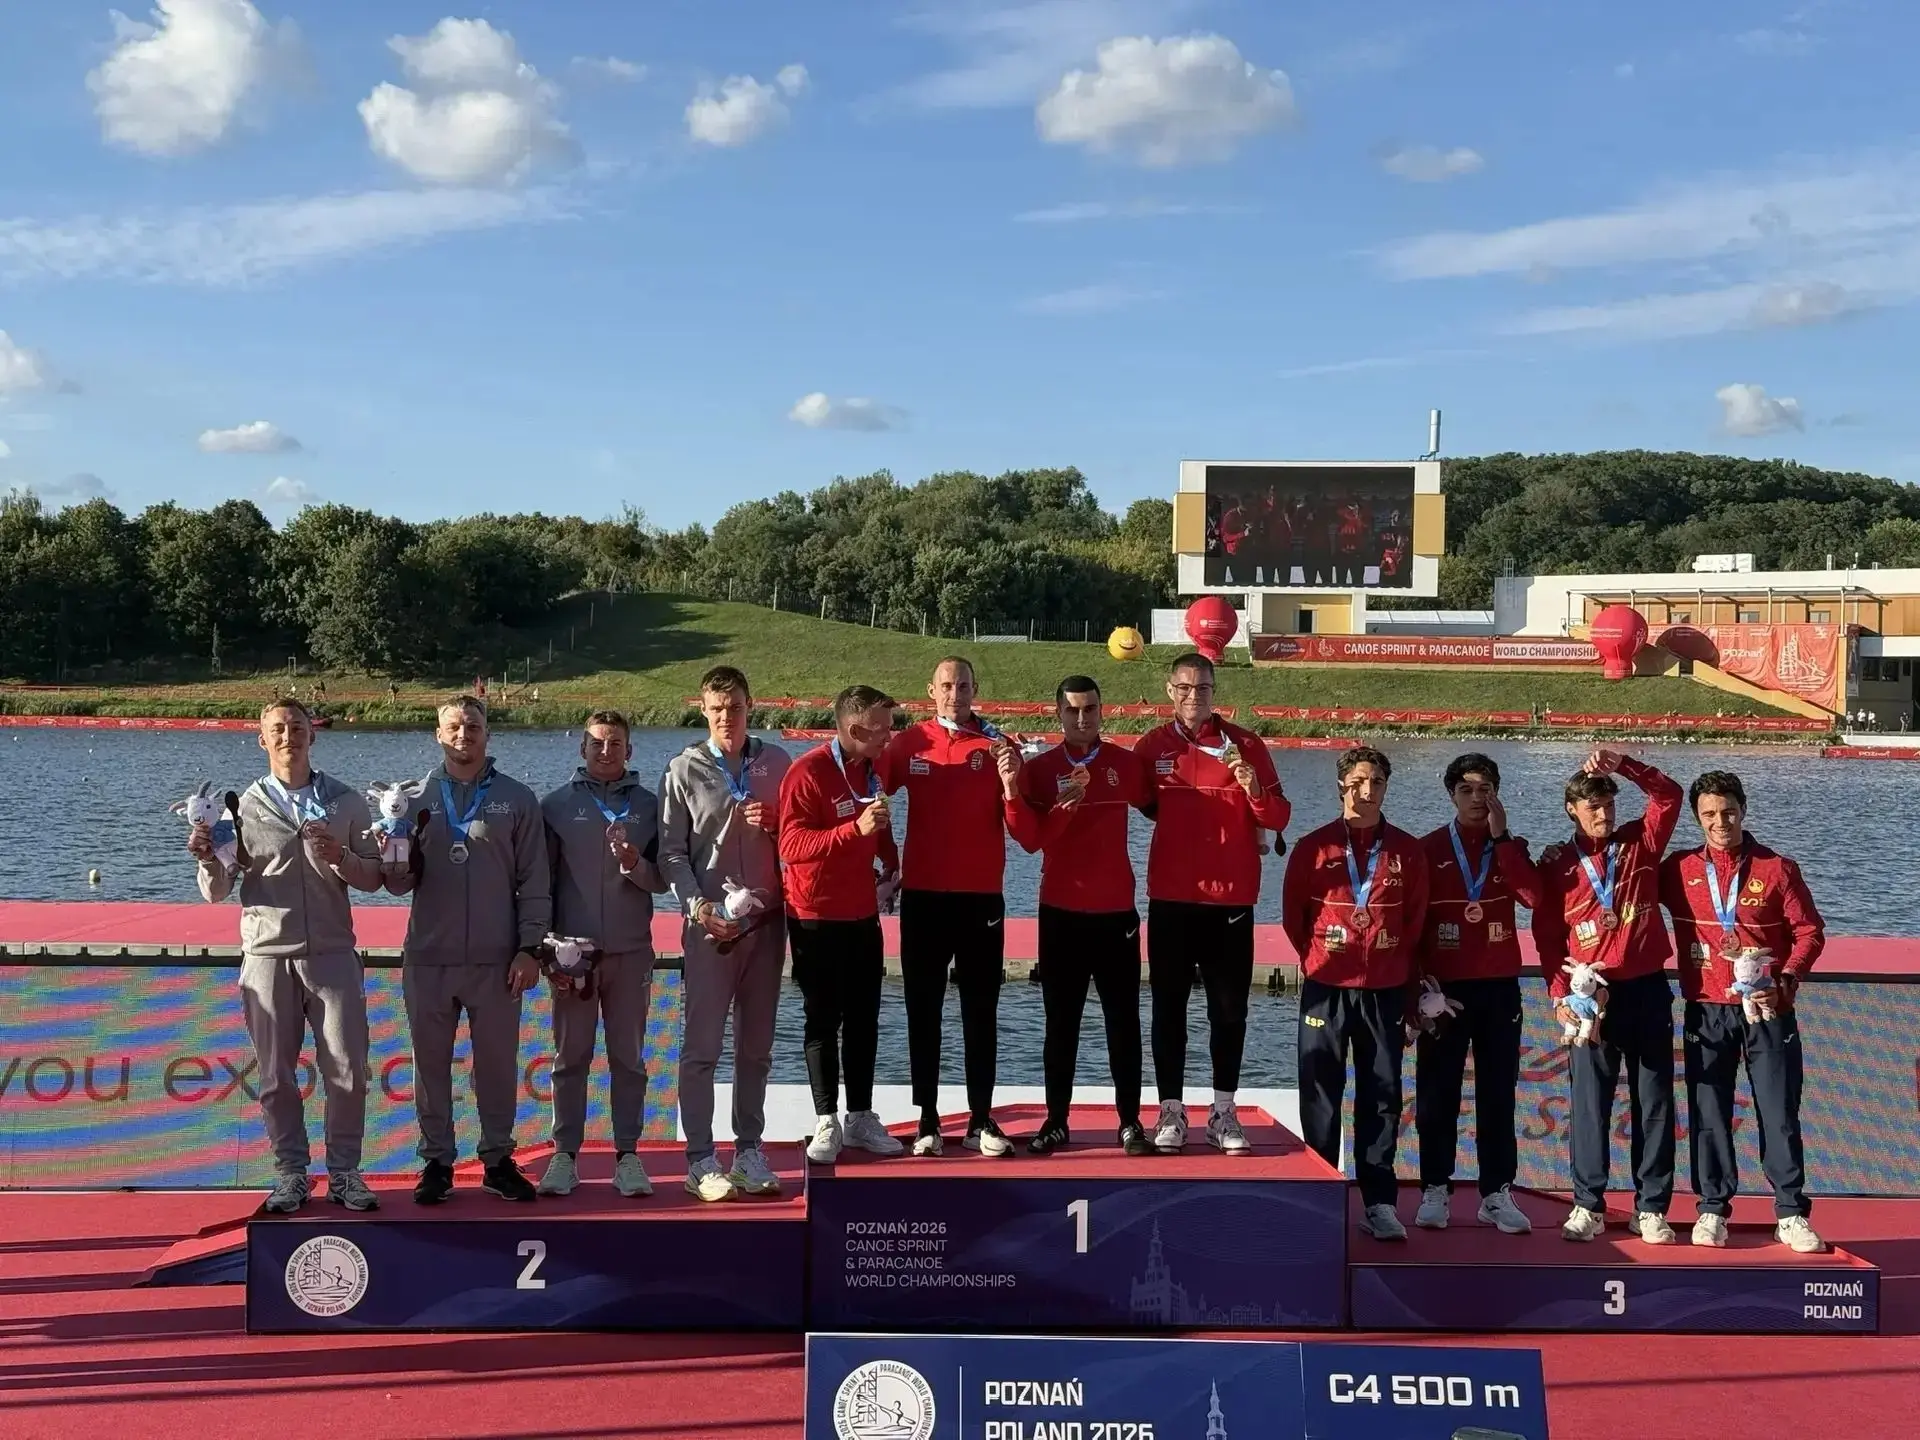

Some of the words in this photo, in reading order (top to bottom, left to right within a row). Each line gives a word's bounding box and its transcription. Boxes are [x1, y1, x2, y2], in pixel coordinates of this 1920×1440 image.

[1344, 643, 1379, 655] CANOE
[1381, 644, 1417, 655] SPRINT
[1418, 645, 1427, 656] &
[1429, 645, 1490, 657] PARACANOE
[1494, 646, 1527, 657] WORLD
[1529, 646, 1598, 657] CHAMPIONSHIP
[1304, 1015, 1325, 1028] ESP
[846, 1218, 907, 1235] POZNAŃ
[911, 1222, 947, 1235] 2026
[1066, 1199, 1090, 1254] 1
[845, 1239, 895, 1252] CANOE
[897, 1239, 948, 1252] SPRINT
[516, 1240, 547, 1289] 2
[845, 1257, 855, 1269] &
[858, 1257, 943, 1269] PARACANOE
[845, 1274, 896, 1288] WORLD
[899, 1274, 1016, 1288] CHAMPIONSHIPS
[1803, 1280, 1863, 1297] POZNAŃ
[1603, 1280, 1625, 1316] 3
[1803, 1305, 1862, 1320] POLAND
[880, 1363, 914, 1379] PARACANOE
[842, 1375, 860, 1396] SPRINT
[911, 1376, 928, 1396] WORLD
[985, 1377, 1083, 1406] POZNAŃ
[1329, 1373, 1382, 1404] C4
[1391, 1375, 1473, 1406] 500
[1484, 1384, 1520, 1408] m
[837, 1397, 848, 1419] CANOE
[985, 1421, 1082, 1440] POLAND
[1090, 1423, 1155, 1440] 2026
